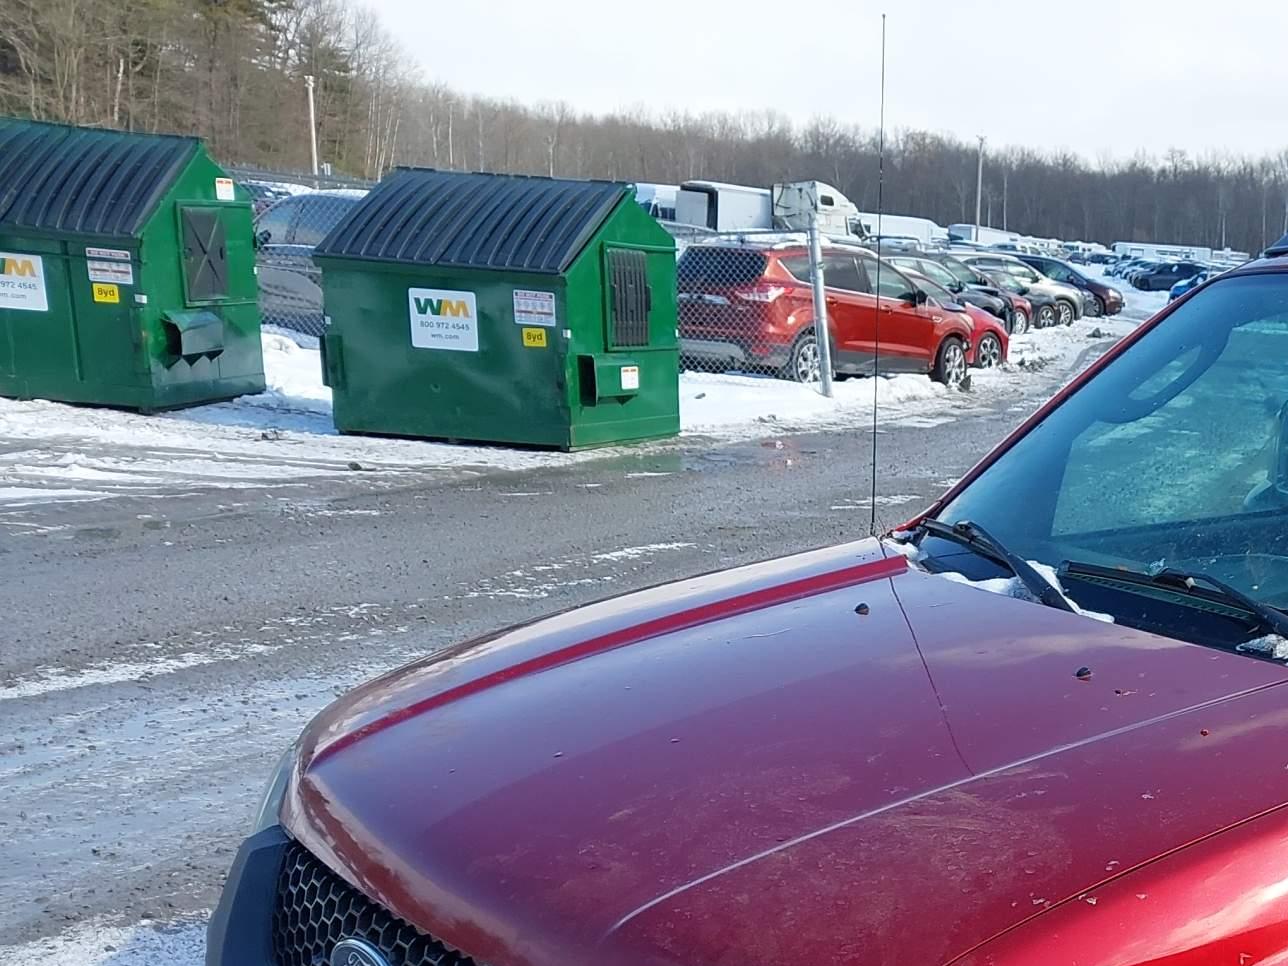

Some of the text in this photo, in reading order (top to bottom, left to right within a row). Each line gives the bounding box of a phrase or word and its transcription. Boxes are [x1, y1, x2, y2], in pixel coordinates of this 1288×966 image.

[0, 258, 36, 277] M
[413, 297, 470, 318] WM
[452, 323, 470, 331] 4545
